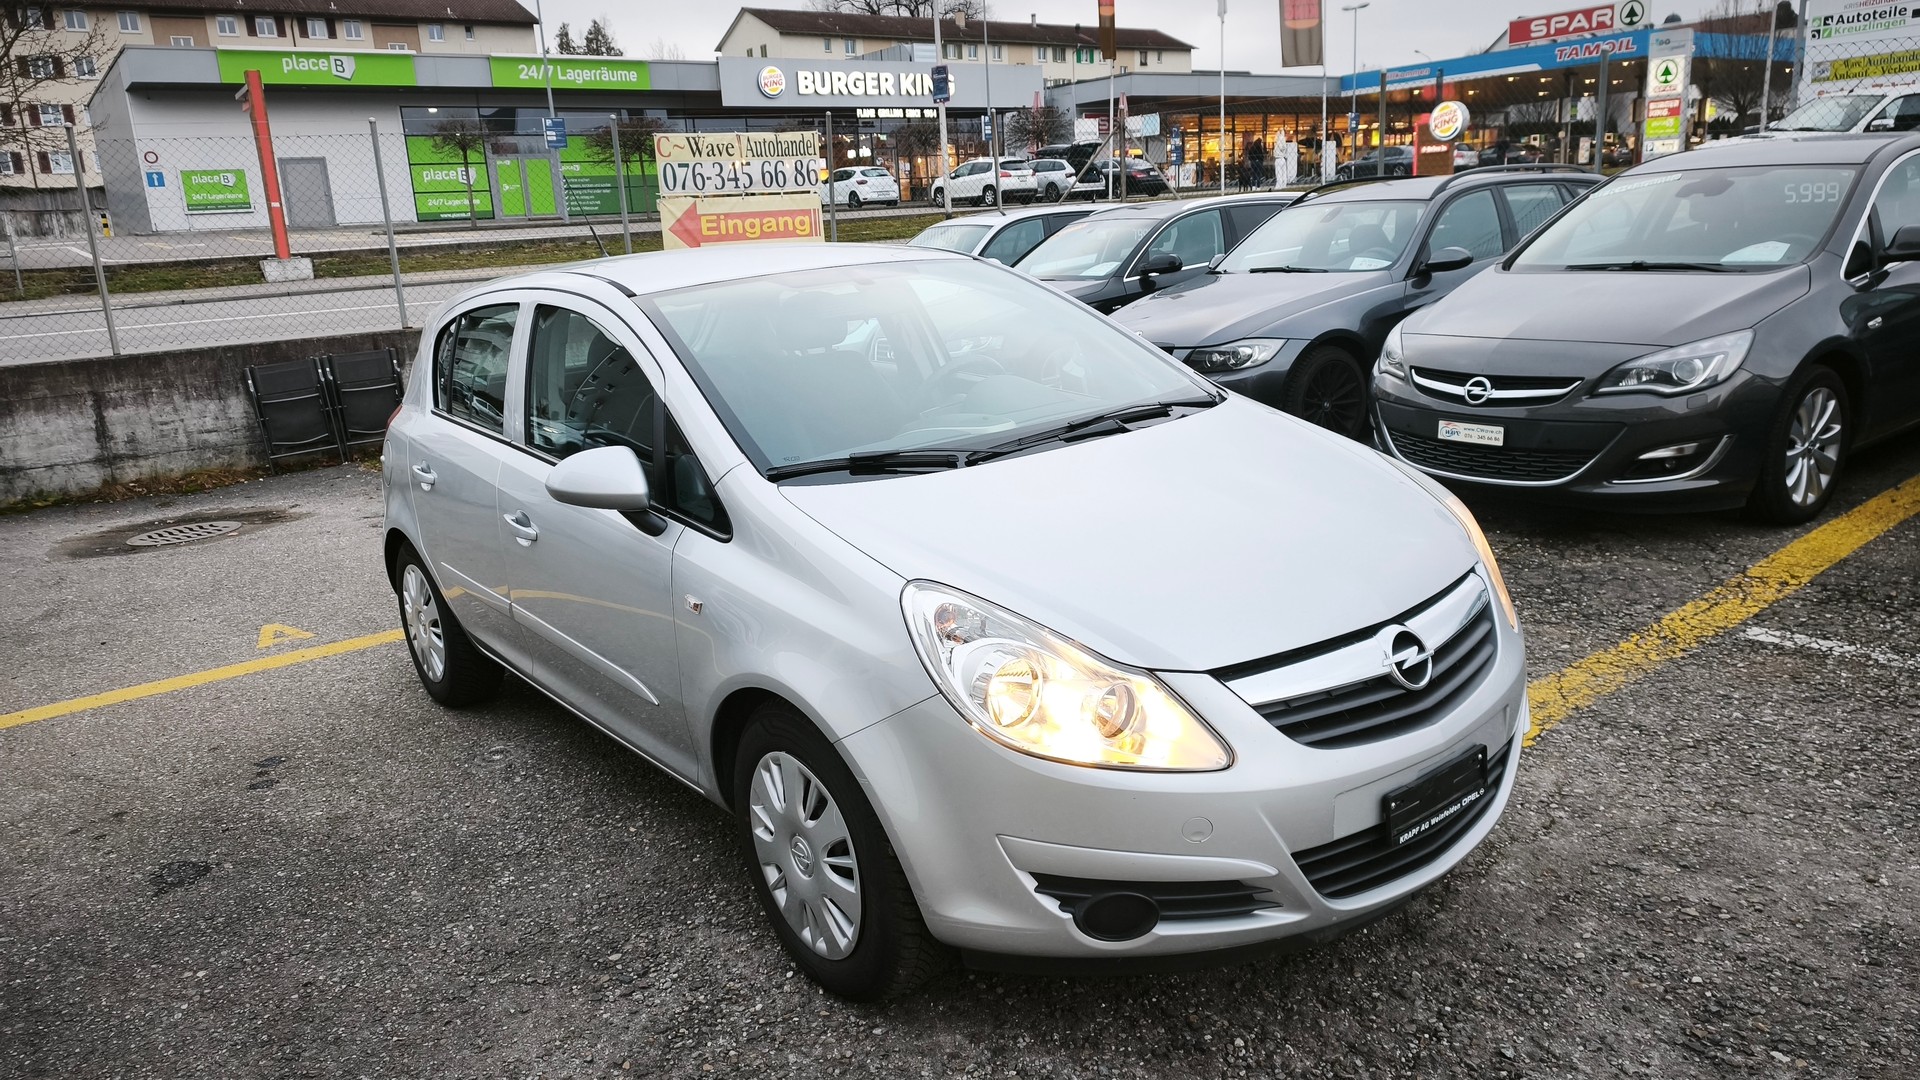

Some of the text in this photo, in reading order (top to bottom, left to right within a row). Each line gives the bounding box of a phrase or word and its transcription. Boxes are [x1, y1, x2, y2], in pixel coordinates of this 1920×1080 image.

[1530, 8, 1613, 38] SPAR
[1835, 6, 1908, 25] Autoteile
[1834, 19, 1907, 35] Kreuzlingen
[1556, 37, 1637, 62] TAMOIL
[281, 54, 346, 73] place B
[1881, 63, 1920, 75] Verkau
[518, 64, 638, 84] 24/7 Lagerräume
[796, 70, 896, 97] BURGER
[763, 79, 783, 89] KING
[1433, 115, 1458, 131] KING
[745, 133, 818, 158] Autohandel
[191, 173, 220, 184] place
[423, 168, 457, 183] place
[662, 159, 819, 191] 076-345 66 86
[700, 214, 811, 238] Eingang
[1399, 791, 1480, 844] KRAPF AG Weinfelden OPEL
